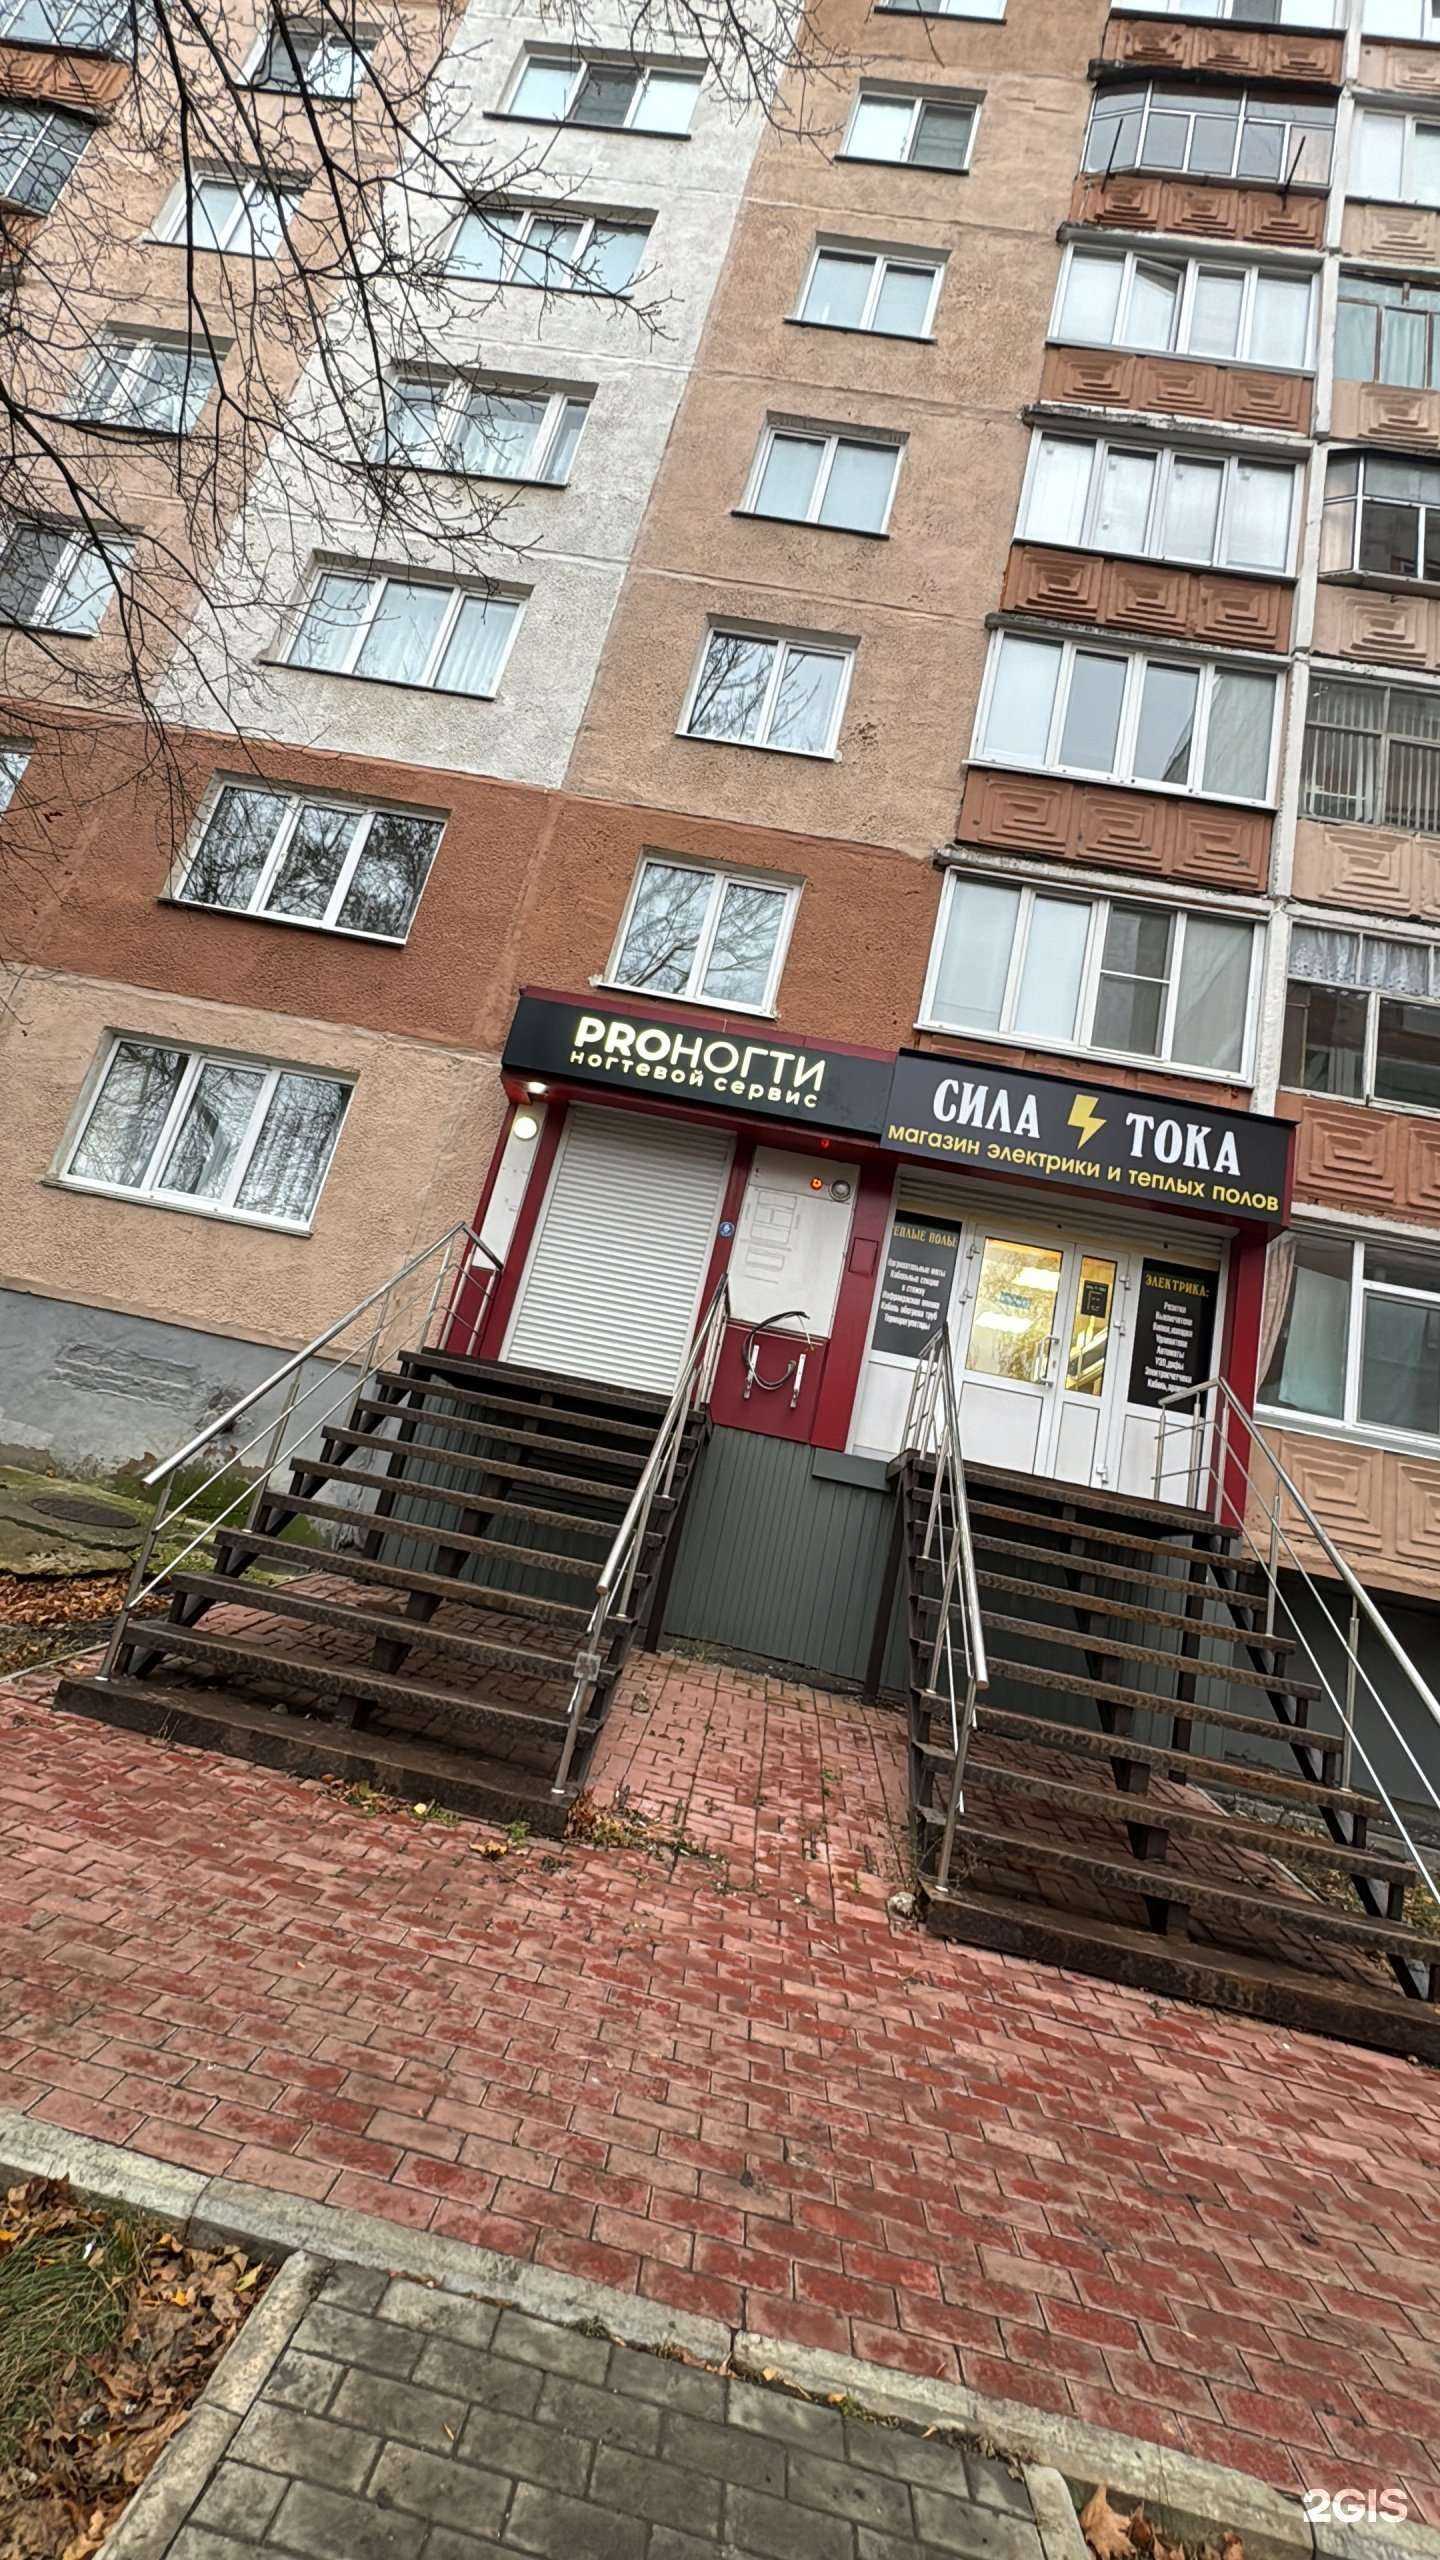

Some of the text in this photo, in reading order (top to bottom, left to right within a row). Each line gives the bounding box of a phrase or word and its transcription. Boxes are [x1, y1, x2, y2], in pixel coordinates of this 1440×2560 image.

[570, 1050, 818, 1108] ногтевой сервис
[574, 1016, 826, 1091] PROНОГТИ
[933, 1078, 1241, 1176] СИЛА ТОКА
[888, 1125, 1279, 1211] магазин электрики и теплых полов
